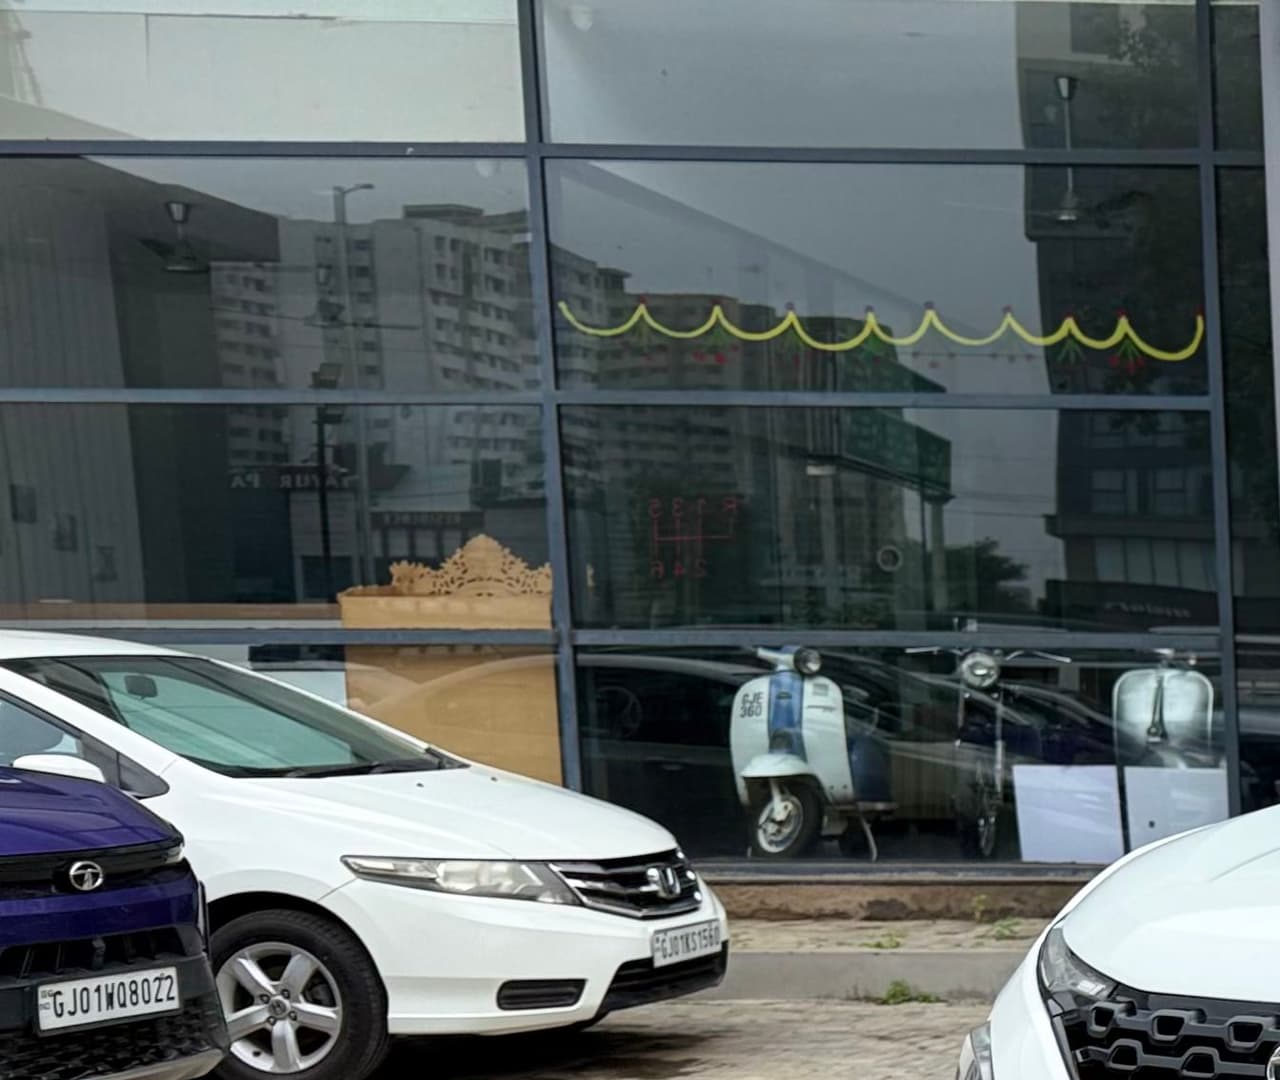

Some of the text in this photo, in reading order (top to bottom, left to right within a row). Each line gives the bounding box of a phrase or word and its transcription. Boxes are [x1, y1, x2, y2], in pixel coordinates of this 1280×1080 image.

[741, 691, 764, 704] GJE
[740, 704, 762, 718] 360
[52, 975, 175, 1018] GJ01WQ8022
